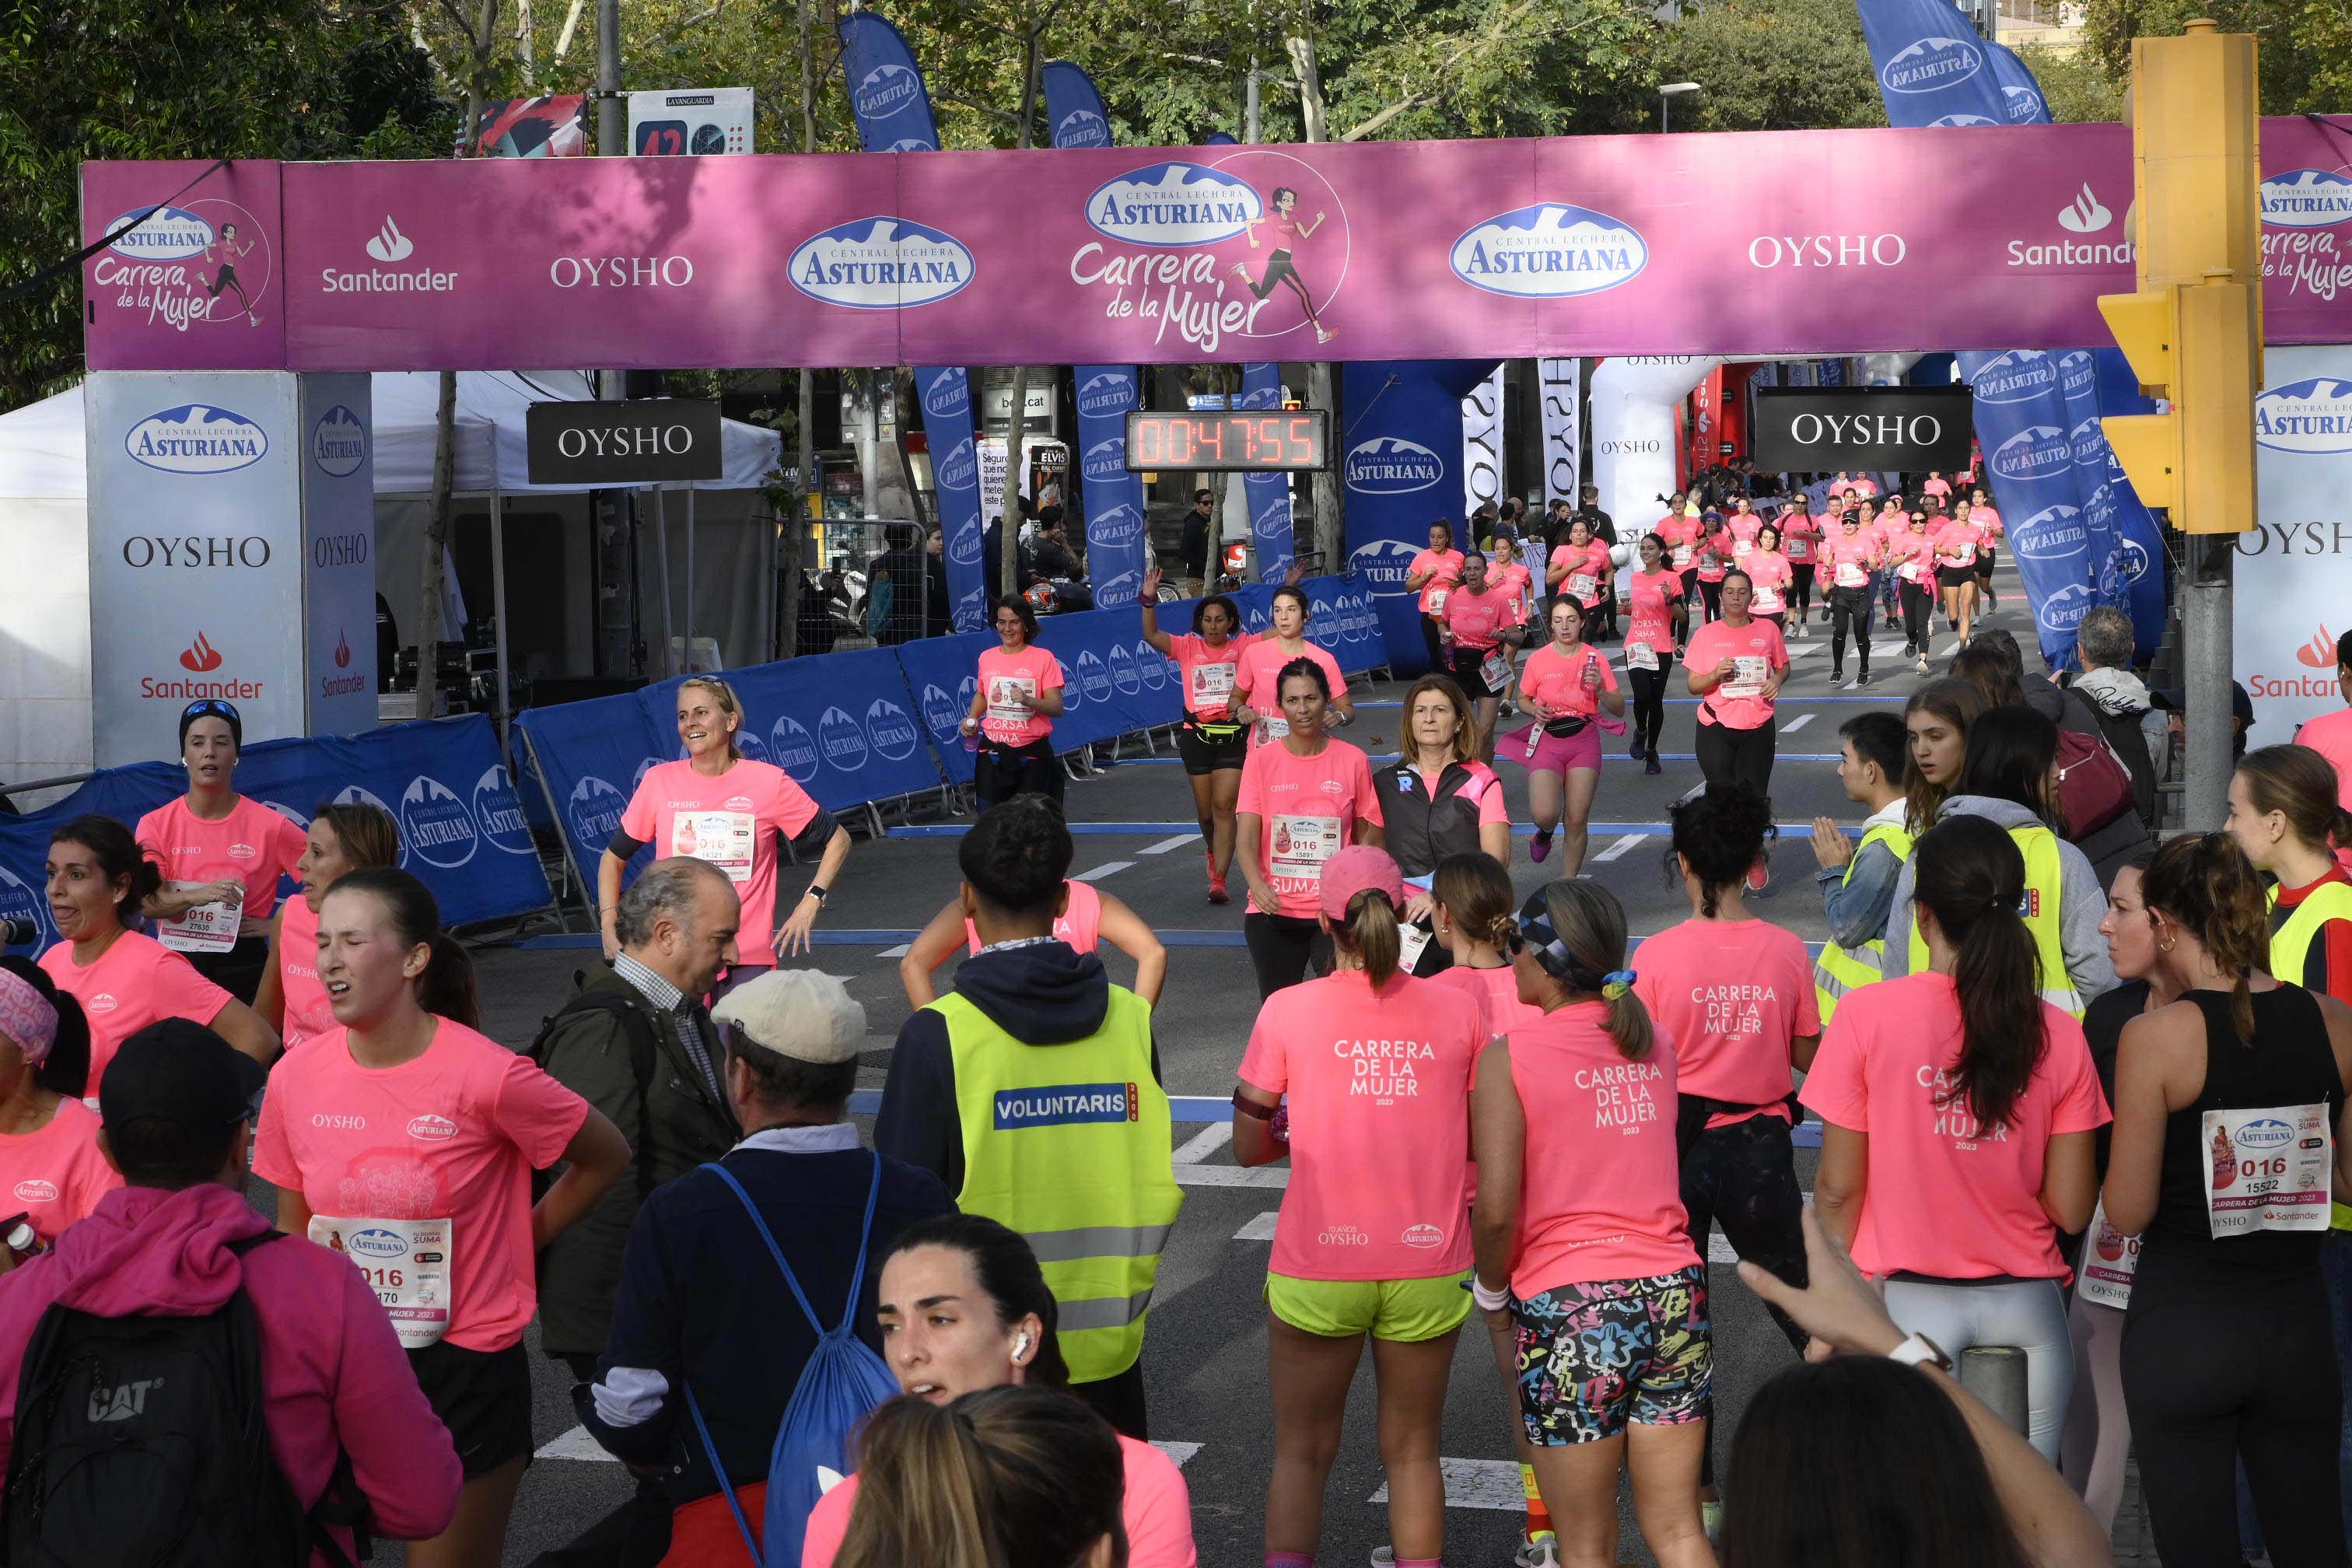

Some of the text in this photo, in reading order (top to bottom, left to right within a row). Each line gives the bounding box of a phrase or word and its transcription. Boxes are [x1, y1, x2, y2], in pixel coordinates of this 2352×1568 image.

[674, 96, 714, 105] VANGUARDIA
[1125, 189, 1244, 201] CENTRAL LECHERA
[1100, 193, 1248, 226] ASTURIANA
[1496, 234, 1626, 247] CENTRAL LECHERA
[2261, 233, 2335, 254] arrera
[831, 248, 954, 258] CENTRAL LECHERA
[1465, 238, 1632, 275] ASTURIANA
[1748, 233, 1906, 268] OYSHO
[2007, 240, 2137, 266] Santand
[94, 257, 186, 286] Carrera
[550, 256, 694, 288] OYSHO
[802, 251, 961, 285] ASTURIANA
[1070, 242, 1216, 285] Carrera
[322, 268, 458, 292] Santander
[2279, 254, 2352, 301] la Muje
[117, 285, 221, 331] de la Mujer
[1106, 282, 1271, 353] de la Mujer
[1002, 396, 1044, 408] b.cat
[2277, 404, 2329, 413] CENTRAL
[1790, 413, 1941, 446] OYSHO
[2256, 406, 2352, 436] ASTURI
[136, 430, 258, 457] ASTURIANA
[317, 433, 362, 460] ASTURIANA
[558, 425, 693, 457] OYSHO
[1138, 418, 1312, 462] 00:47:55
[1601, 439, 1661, 457] OYSHO
[1041, 453, 1066, 463] ELVIS
[983, 466, 999, 475] que
[983, 474, 1006, 485] quiere
[1348, 460, 1437, 482] ASTURIANA
[985, 496, 999, 505] este
[2234, 521, 2352, 555] OYSH
[123, 536, 271, 568] OYSHO
[315, 533, 367, 568] OYSHO
[141, 677, 263, 699] Santander
[322, 673, 366, 698] Santander
[2249, 674, 2340, 698] Santa
[1260, 706, 1272, 717] TU
[824, 733, 866, 758] ASTURIANA
[988, 731, 1020, 743] SUMA
[776, 744, 817, 768] ASTURIANA
[667, 801, 701, 810] OYSHO
[480, 802, 530, 835] ASTUR
[408, 813, 474, 848] ASTURIANA
[171, 846, 201, 856] OYSHO
[700, 838, 726, 849] 016
[1293, 841, 1317, 850] 016
[1272, 878, 1320, 893] SUMA
[188, 909, 214, 922] 016
[189, 922, 209, 932] 27630
[163, 939, 187, 947] OYSHO
[1691, 984, 1776, 1003] CARRERA
[1707, 1001, 1759, 1017] DE LA
[1704, 1016, 1762, 1034] MUJER
[1334, 1039, 1435, 1060] CARRERA
[1353, 1059, 1415, 1077] DE LA
[1574, 1062, 1663, 1090] CARRERA
[1349, 1078, 1419, 1097] MUJER
[1596, 1084, 1652, 1108] DE LA
[997, 1094, 1125, 1119] VOLUNTARIS
[1594, 1101, 1657, 1129] MUJER
[312, 1114, 366, 1129] OYSHO
[410, 1124, 455, 1136] ASTURIANA
[1934, 1115, 2007, 1143] MUJR
[2298, 1122, 2321, 1130] SUMA
[1622, 1126, 1640, 1136] 2023
[2239, 1130, 2291, 1143] ASTURIANA
[1955, 1142, 1978, 1150] 2023
[2241, 1157, 2287, 1177] 016
[2246, 1179, 2279, 1193] 15522
[2213, 1200, 2246, 1209] CARRERA
[2276, 1212, 2319, 1220] Santander
[354, 1237, 404, 1252] ASTURIANA
[413, 1235, 441, 1244] SUMA
[1318, 1232, 1369, 1245] OYSHO
[1405, 1234, 1441, 1243] ASTURIANA
[362, 1267, 404, 1287] 016
[2098, 1271, 2130, 1283] CARRERA
[376, 1292, 398, 1304] 170
[2091, 1284, 2130, 1300] OYSHO
[389, 1310, 414, 1318] MUJER
[394, 1328, 438, 1338] Santander
[87, 1379, 154, 1423] CAT
